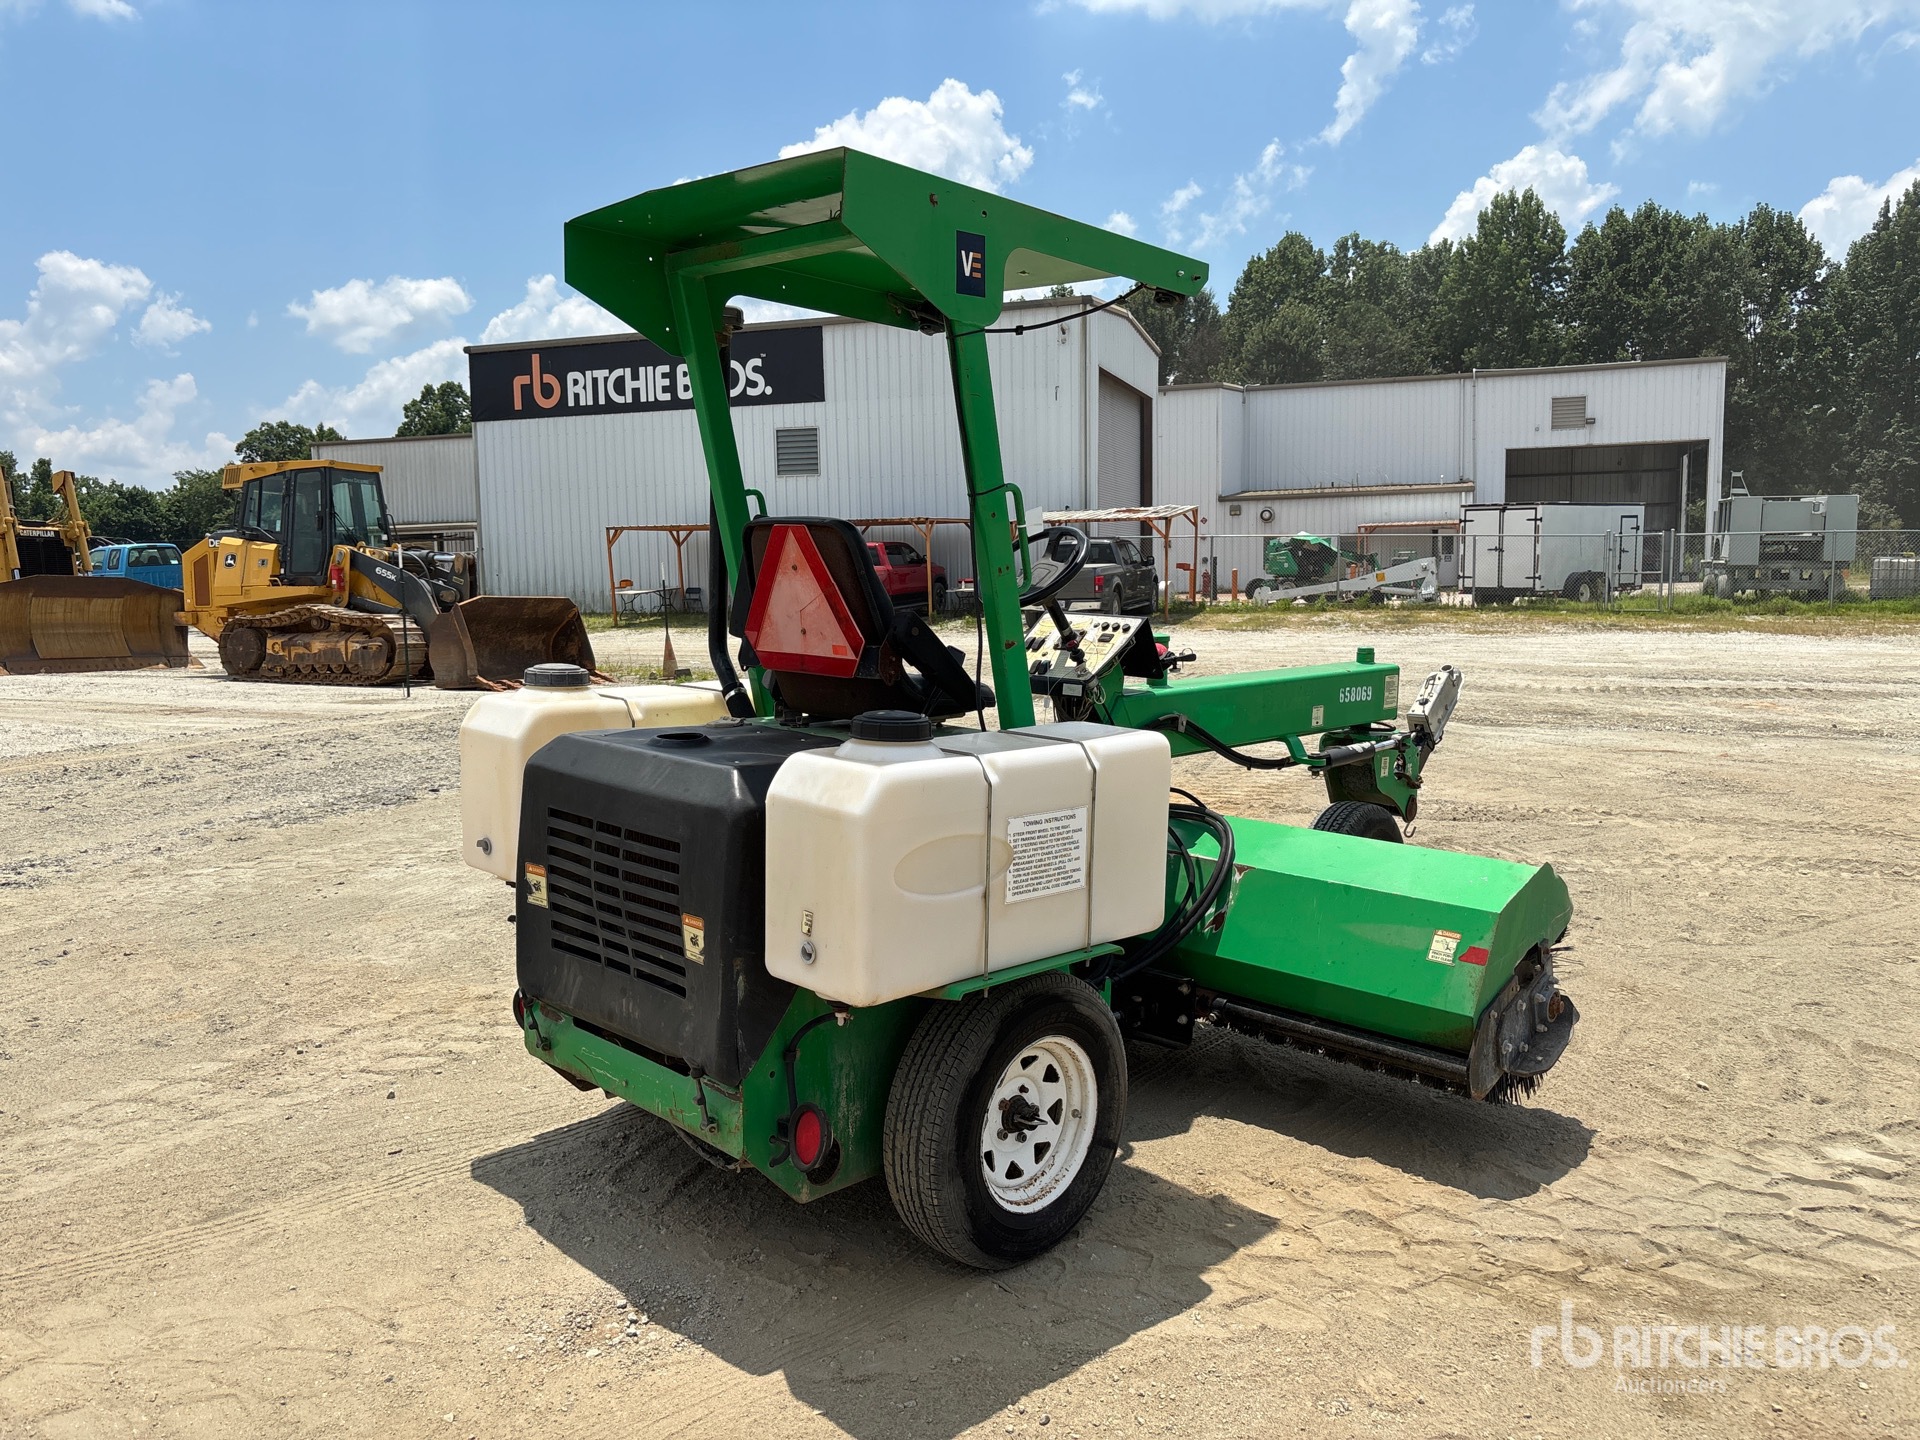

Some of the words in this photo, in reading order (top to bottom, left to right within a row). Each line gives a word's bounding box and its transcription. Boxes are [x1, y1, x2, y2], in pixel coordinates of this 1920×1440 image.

[513, 353, 561, 410] rb
[567, 364, 671, 407] RITCHIE
[677, 358, 773, 400] BOS.
[375, 566, 397, 582] 655K
[1339, 686, 1373, 703] 658069
[1023, 819, 1042, 827] TOWING
[1044, 814, 1076, 824] INSTRUCTIONS
[1013, 859, 1034, 867] BREAKAWAY
[1013, 865, 1033, 873] DISENGAGE
[1443, 930, 1461, 939] DANGER
